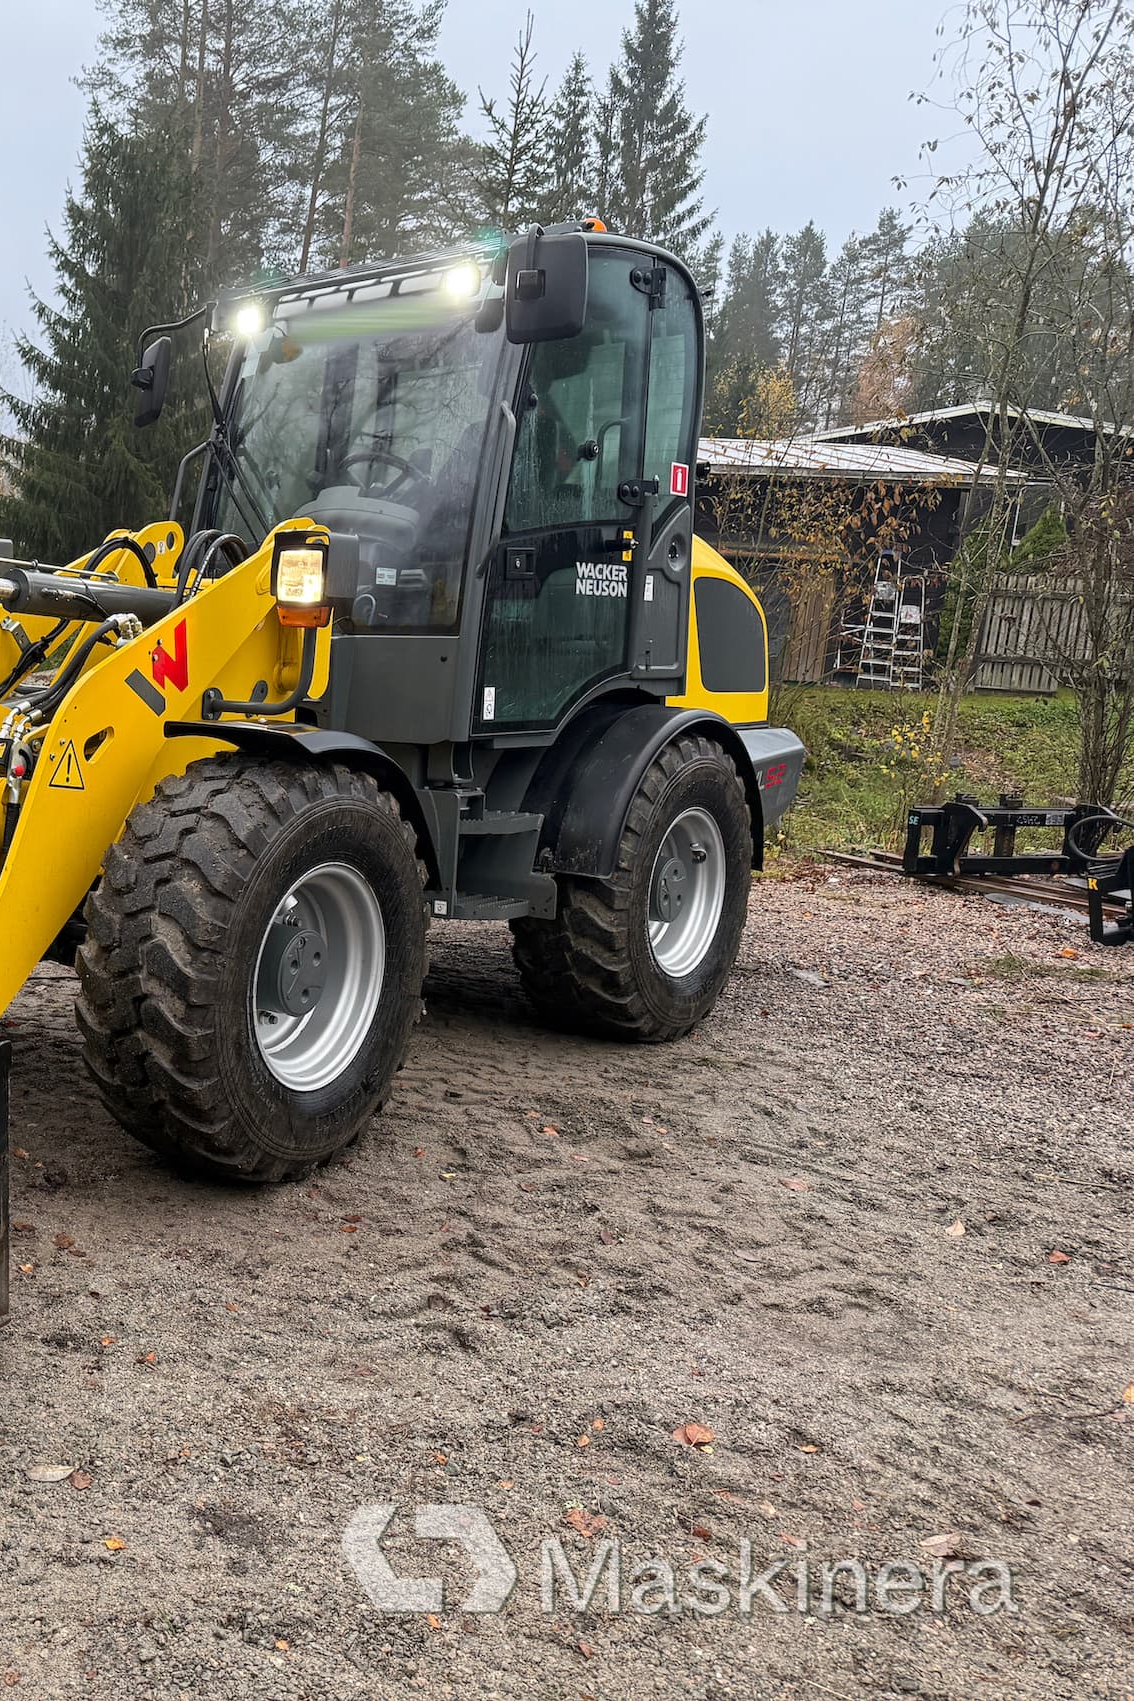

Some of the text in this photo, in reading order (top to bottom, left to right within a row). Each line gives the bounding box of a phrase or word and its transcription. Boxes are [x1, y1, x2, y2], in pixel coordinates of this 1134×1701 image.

[575, 561, 628, 582] WACKER
[575, 578, 628, 598] NEUSON
[908, 815, 920, 826] SE
